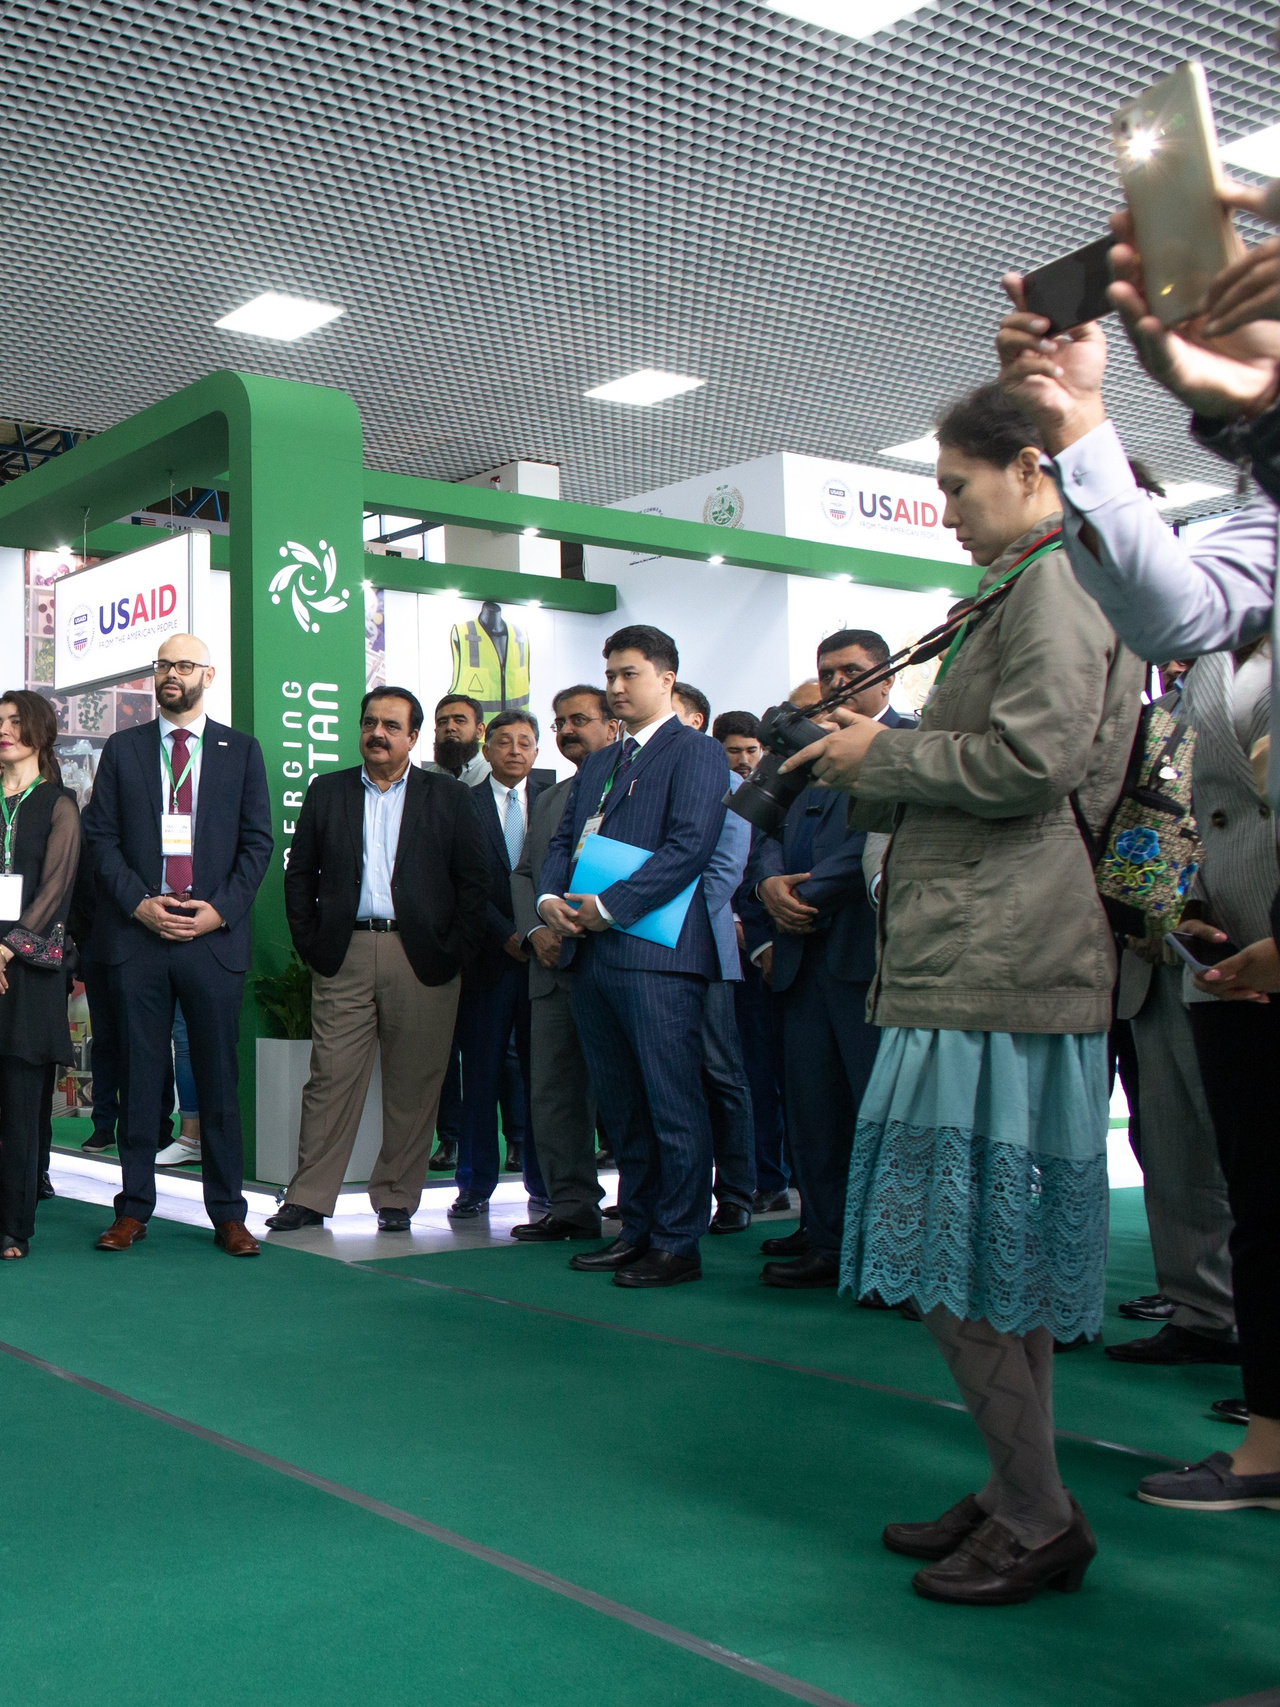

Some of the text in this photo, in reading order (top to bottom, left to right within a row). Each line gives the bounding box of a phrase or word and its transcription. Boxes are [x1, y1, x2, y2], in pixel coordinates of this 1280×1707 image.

[858, 491, 938, 528] USAID
[99, 584, 177, 635] USAID
[99, 639, 114, 649] FROM
[127, 626, 157, 641] AMERICAN
[157, 619, 178, 633] PEOPLE
